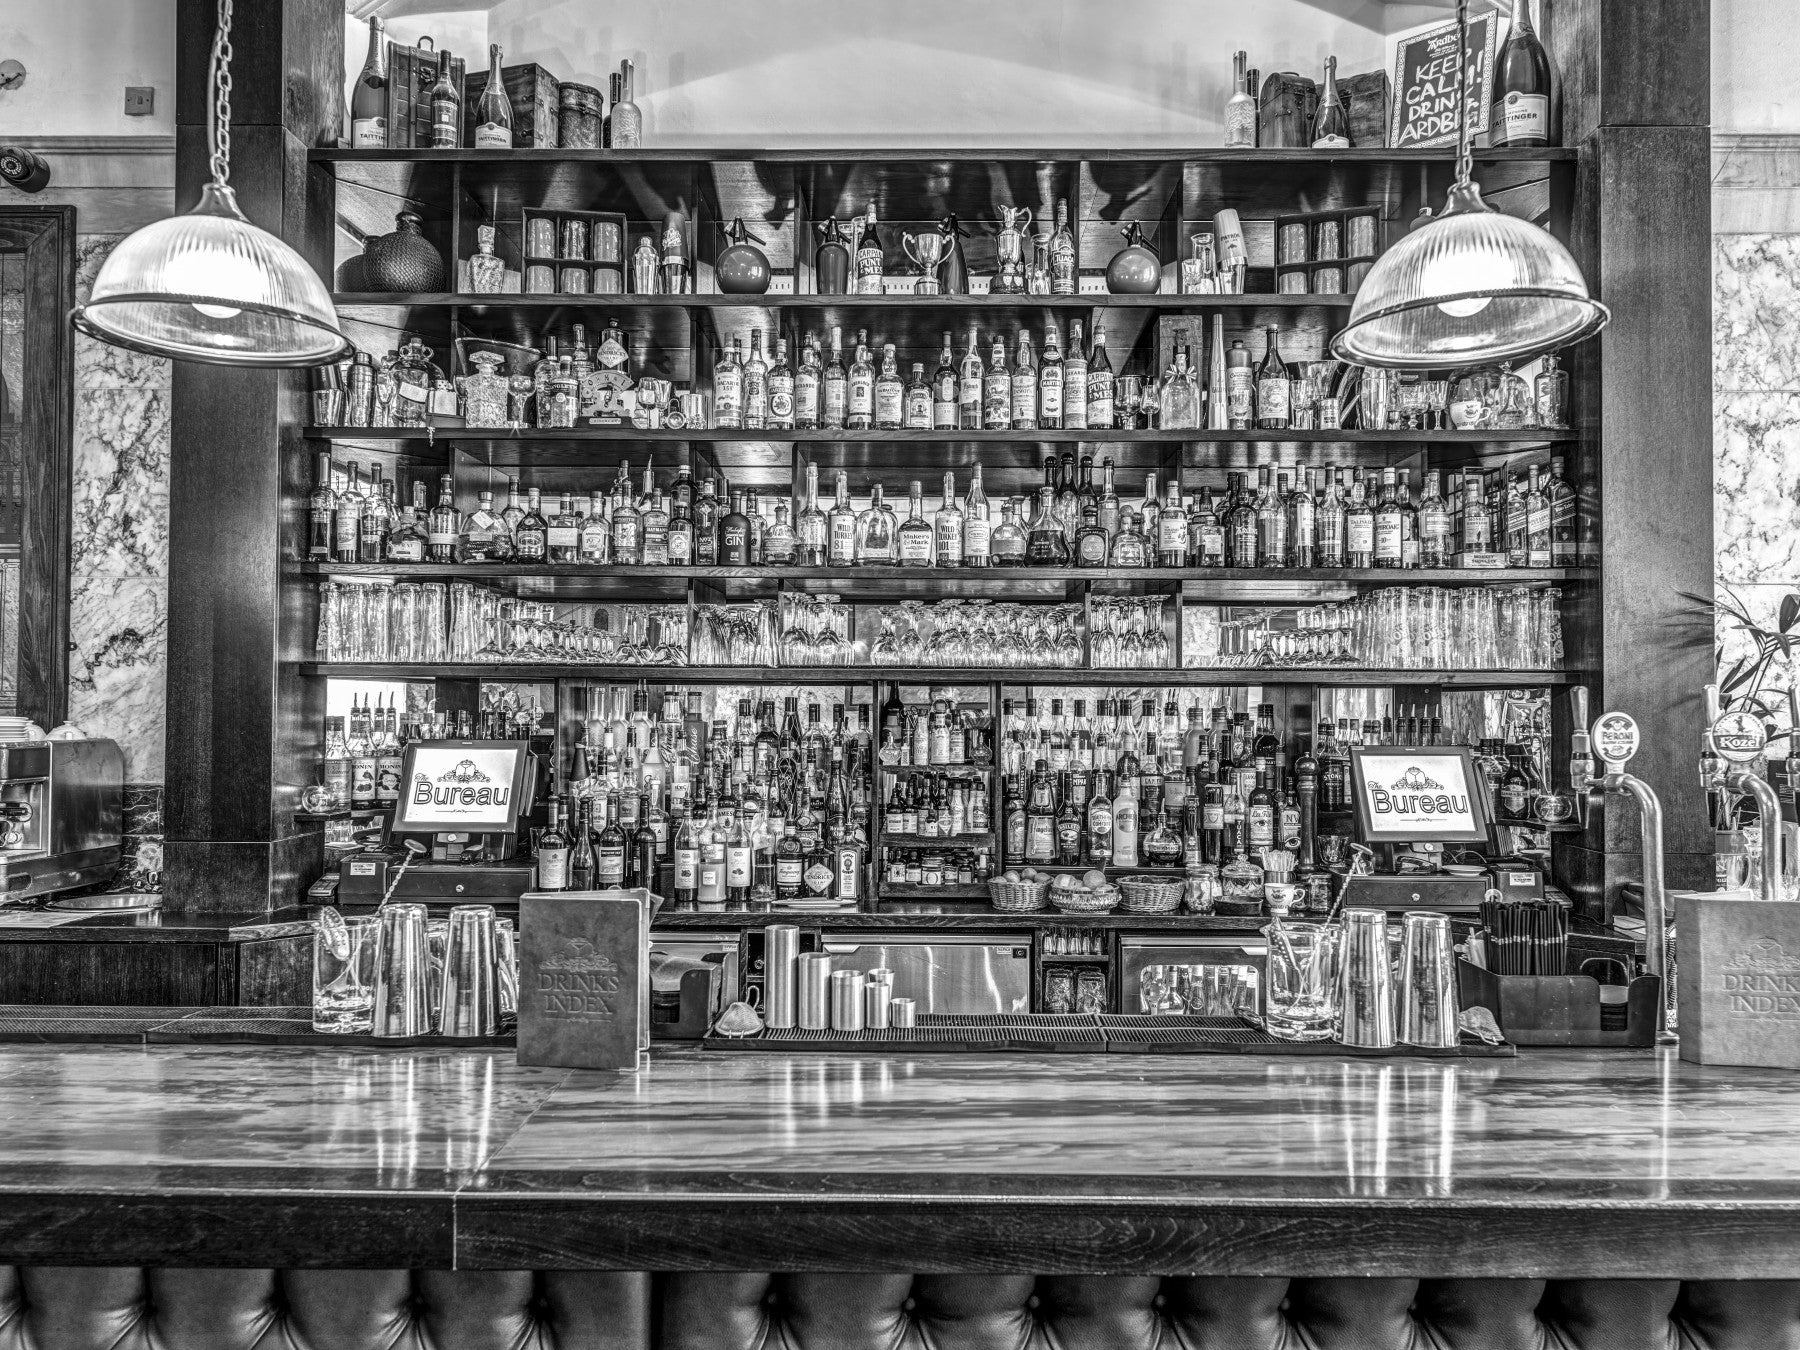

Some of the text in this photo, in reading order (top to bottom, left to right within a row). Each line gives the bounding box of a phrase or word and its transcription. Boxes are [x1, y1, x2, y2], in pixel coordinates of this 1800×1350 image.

[859, 258, 882, 267] PUNT
[1089, 381, 1111, 391] PUNT
[1095, 391, 1113, 400] MES
[837, 523, 851, 532] WILD
[940, 525, 955, 533] WILD
[834, 530, 853, 540] TURKEY
[938, 532, 958, 541] TURKEY
[725, 536, 744, 546] GIN
[834, 540, 844, 550] 81
[938, 541, 949, 551] 101
[1602, 731, 1634, 740] PERONI
[661, 727, 674, 765] Chase
[685, 727, 698, 764] Chase
[1720, 736, 1761, 750] Kozel
[414, 772, 430, 783] The
[1368, 780, 1382, 790] The
[413, 781, 510, 806] Bureau
[1371, 789, 1469, 814] Bureau
[537, 972, 620, 994] DRINKS
[1721, 974, 1800, 993] DRINK
[543, 994, 613, 1015] INDEX
